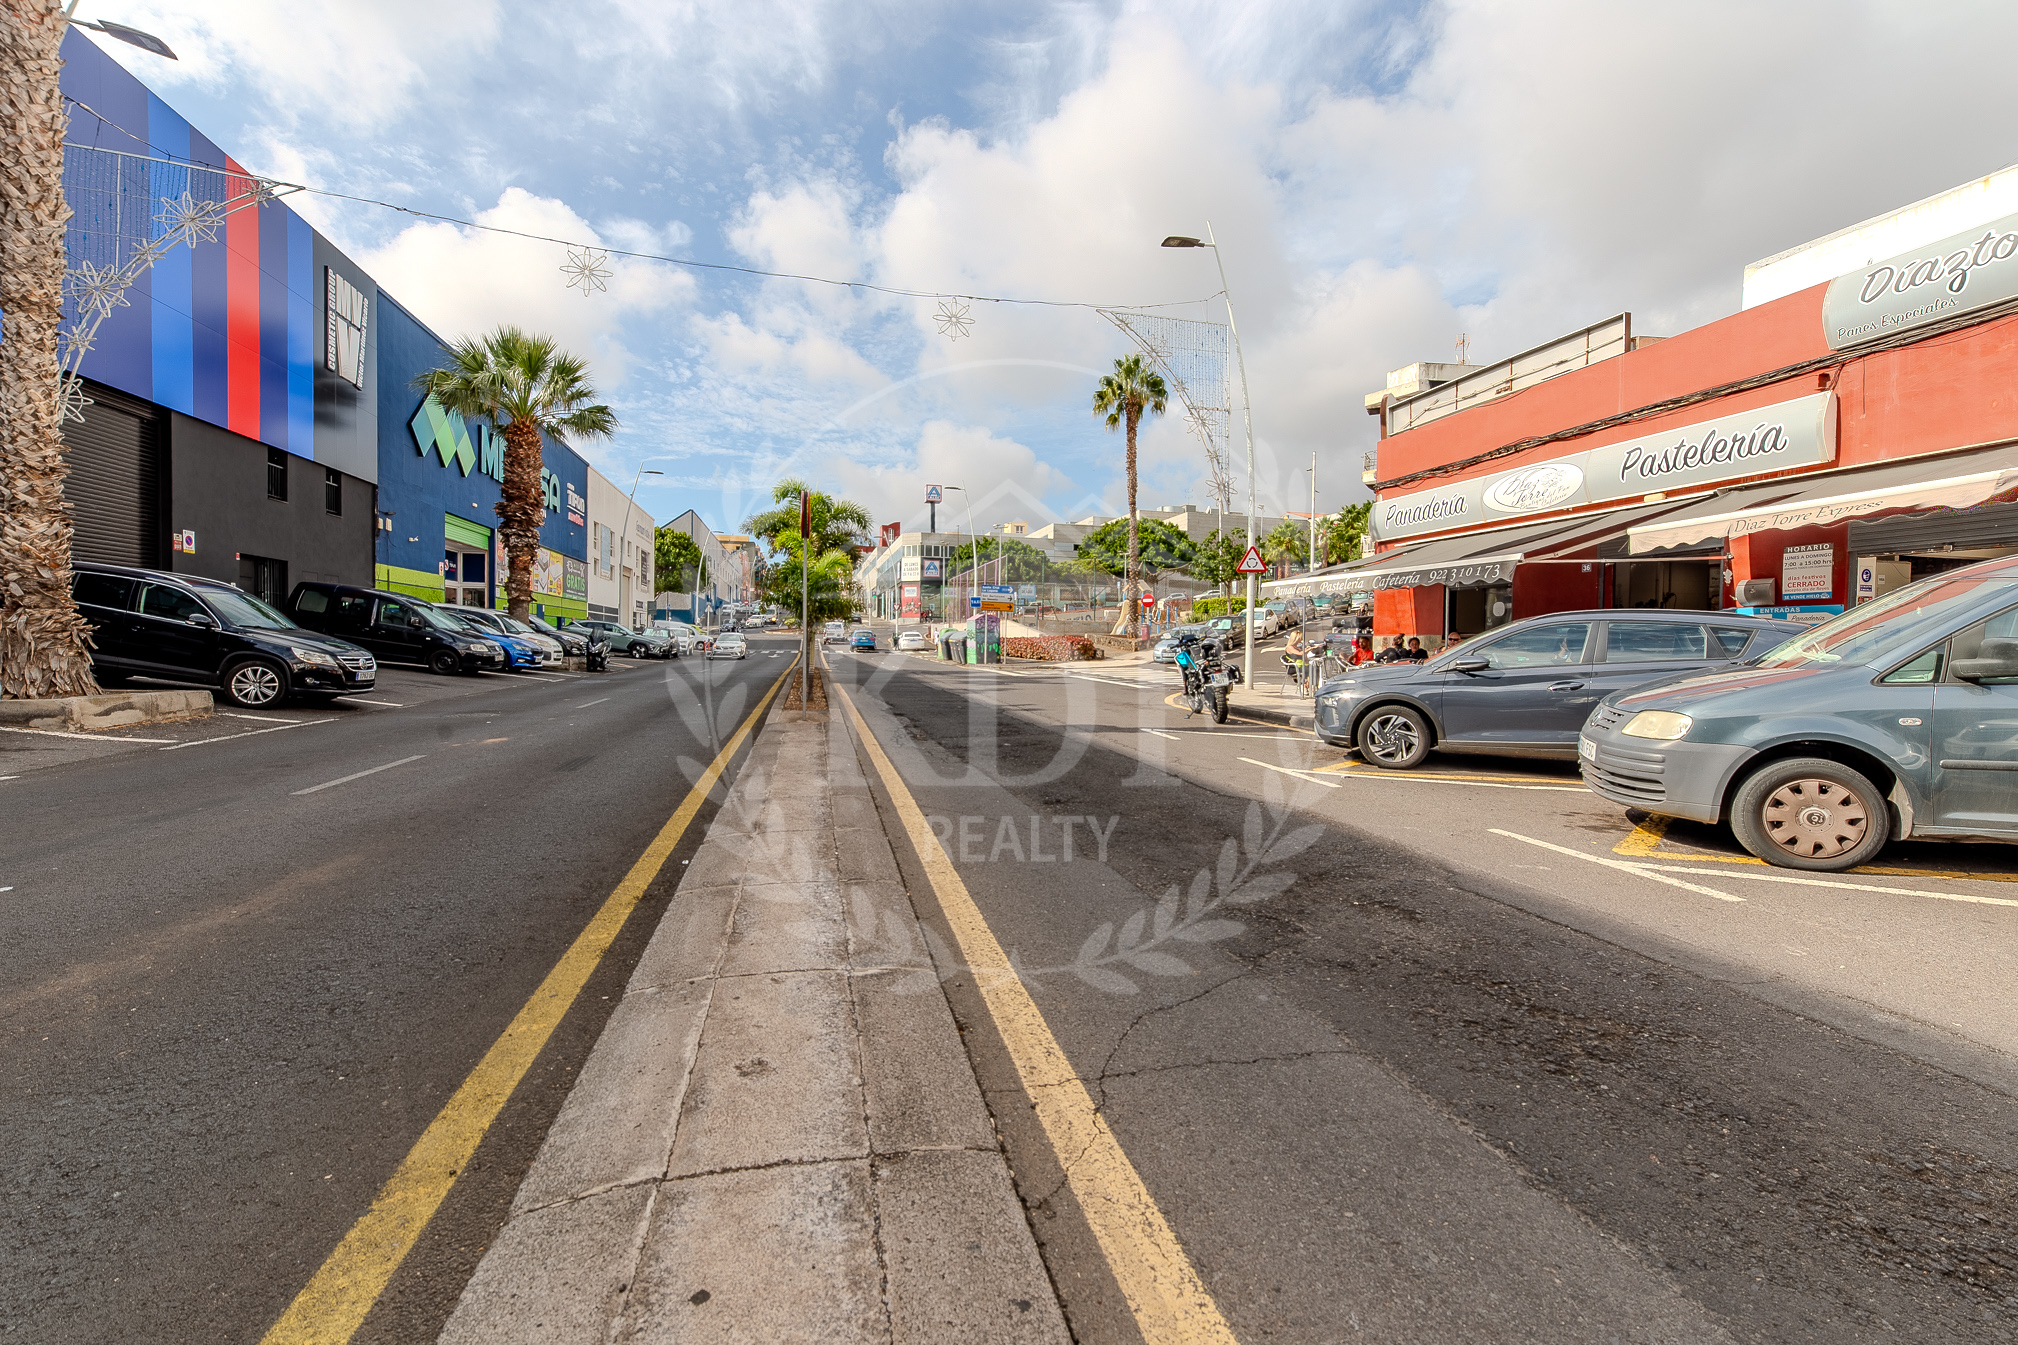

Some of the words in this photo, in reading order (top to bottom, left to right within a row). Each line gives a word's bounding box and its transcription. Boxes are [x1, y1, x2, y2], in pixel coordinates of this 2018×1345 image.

[328, 268, 336, 310] GROUP
[1837, 321, 1879, 340] Panes
[1880, 297, 1959, 326] Especiales
[328, 310, 336, 370] COSMETIC
[1620, 423, 1788, 481] Pastelería
[1385, 494, 1468, 529] Panadería
[1771, 512, 1812, 527] Torre
[1816, 500, 1883, 519] Express
[1787, 544, 1830, 553] HORARIO
[566, 573, 586, 592] GRATIS
[1273, 583, 1312, 597] Panadería
[1320, 578, 1364, 592] Pastelería
[1372, 571, 1421, 591] Cafetería
[1428, 569, 1448, 583] 922
[1449, 566, 1473, 582] 310
[1475, 564, 1500, 579] 173
[1583, 564, 1591, 572] 36
[1787, 580, 1826, 588] CERRADO
[1760, 606, 1800, 614] ENTRADAS
